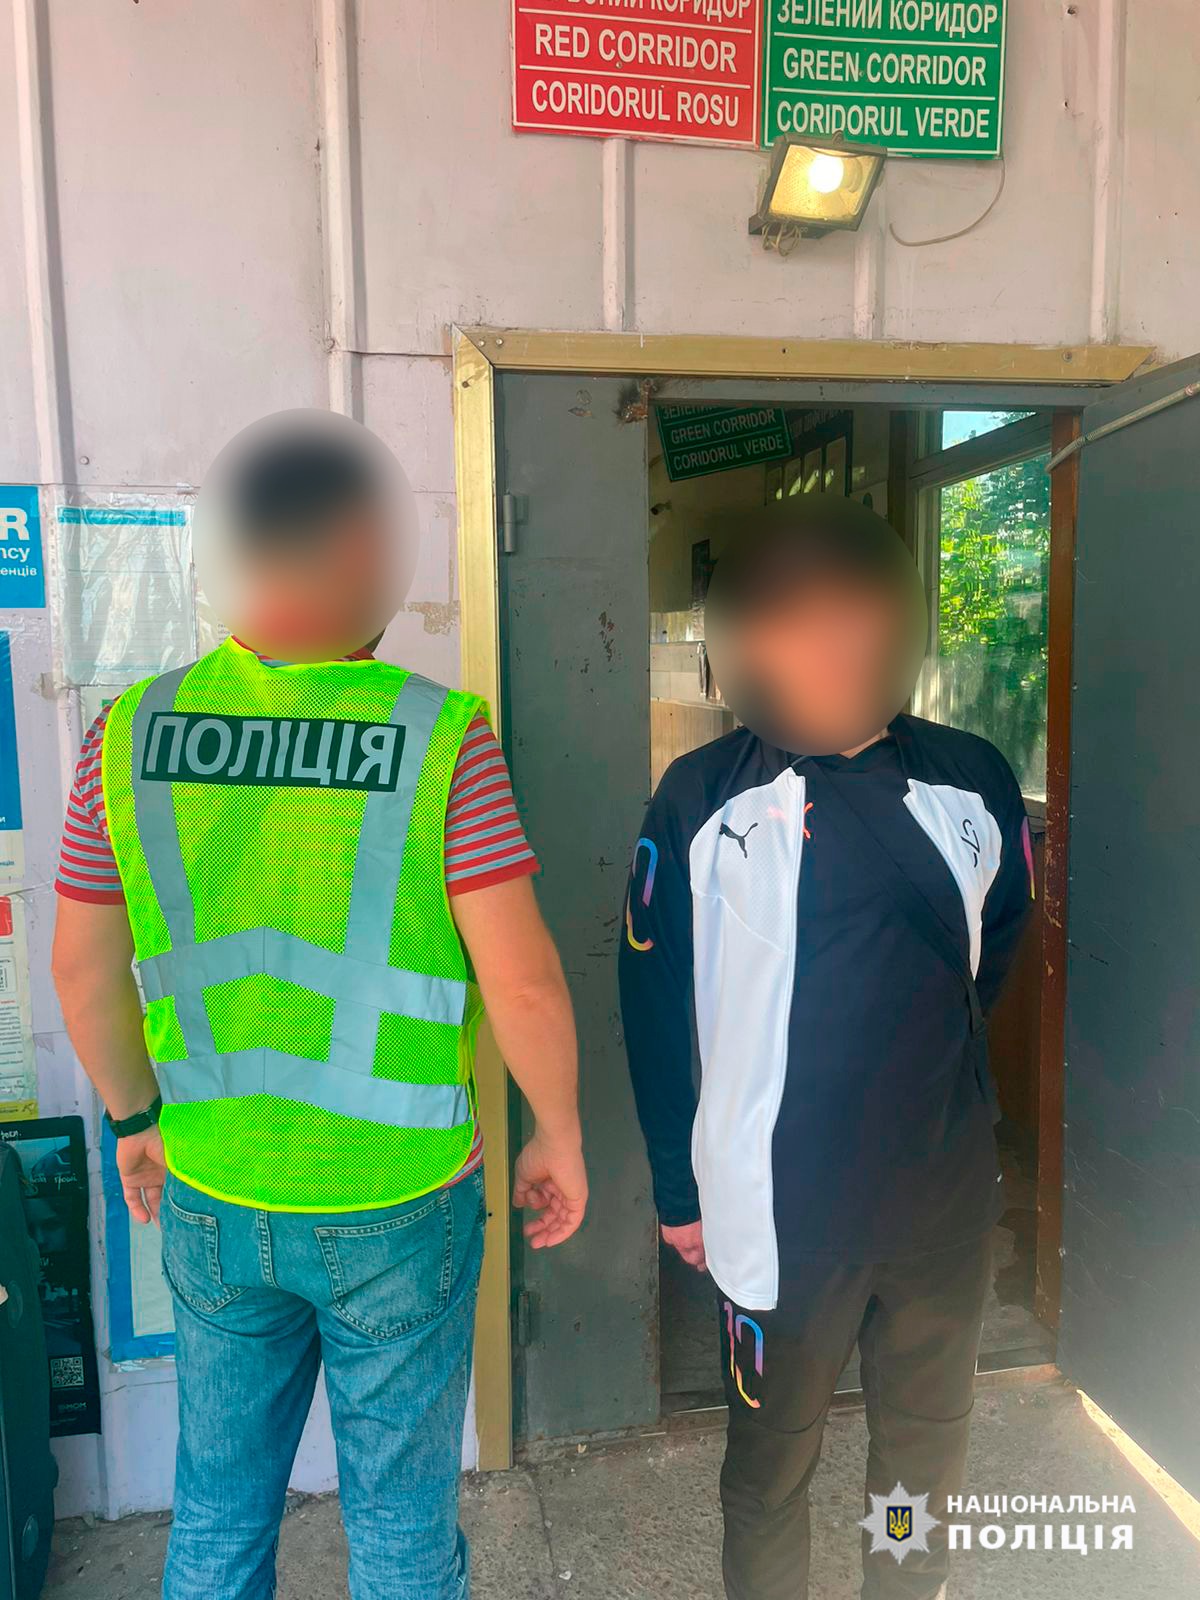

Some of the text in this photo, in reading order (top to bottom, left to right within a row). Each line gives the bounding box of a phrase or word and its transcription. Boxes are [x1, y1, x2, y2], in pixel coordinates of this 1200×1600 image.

[889, 0, 998, 38] КОРИДОР
[535, 23, 737, 73] RED CORRIDOR
[783, 47, 987, 87] GREEN CORRIDOR
[531, 79, 739, 127] CORIDORUL ROSU
[776, 100, 990, 138] CORIDORUL VERDE
[670, 422, 712, 445] GREEN
[712, 408, 777, 436] CORRIDOR
[673, 434, 785, 471] CORIDORUL VERDE
[0, 507, 30, 541] R
[145, 715, 397, 786] ПОЛІЦІЯ
